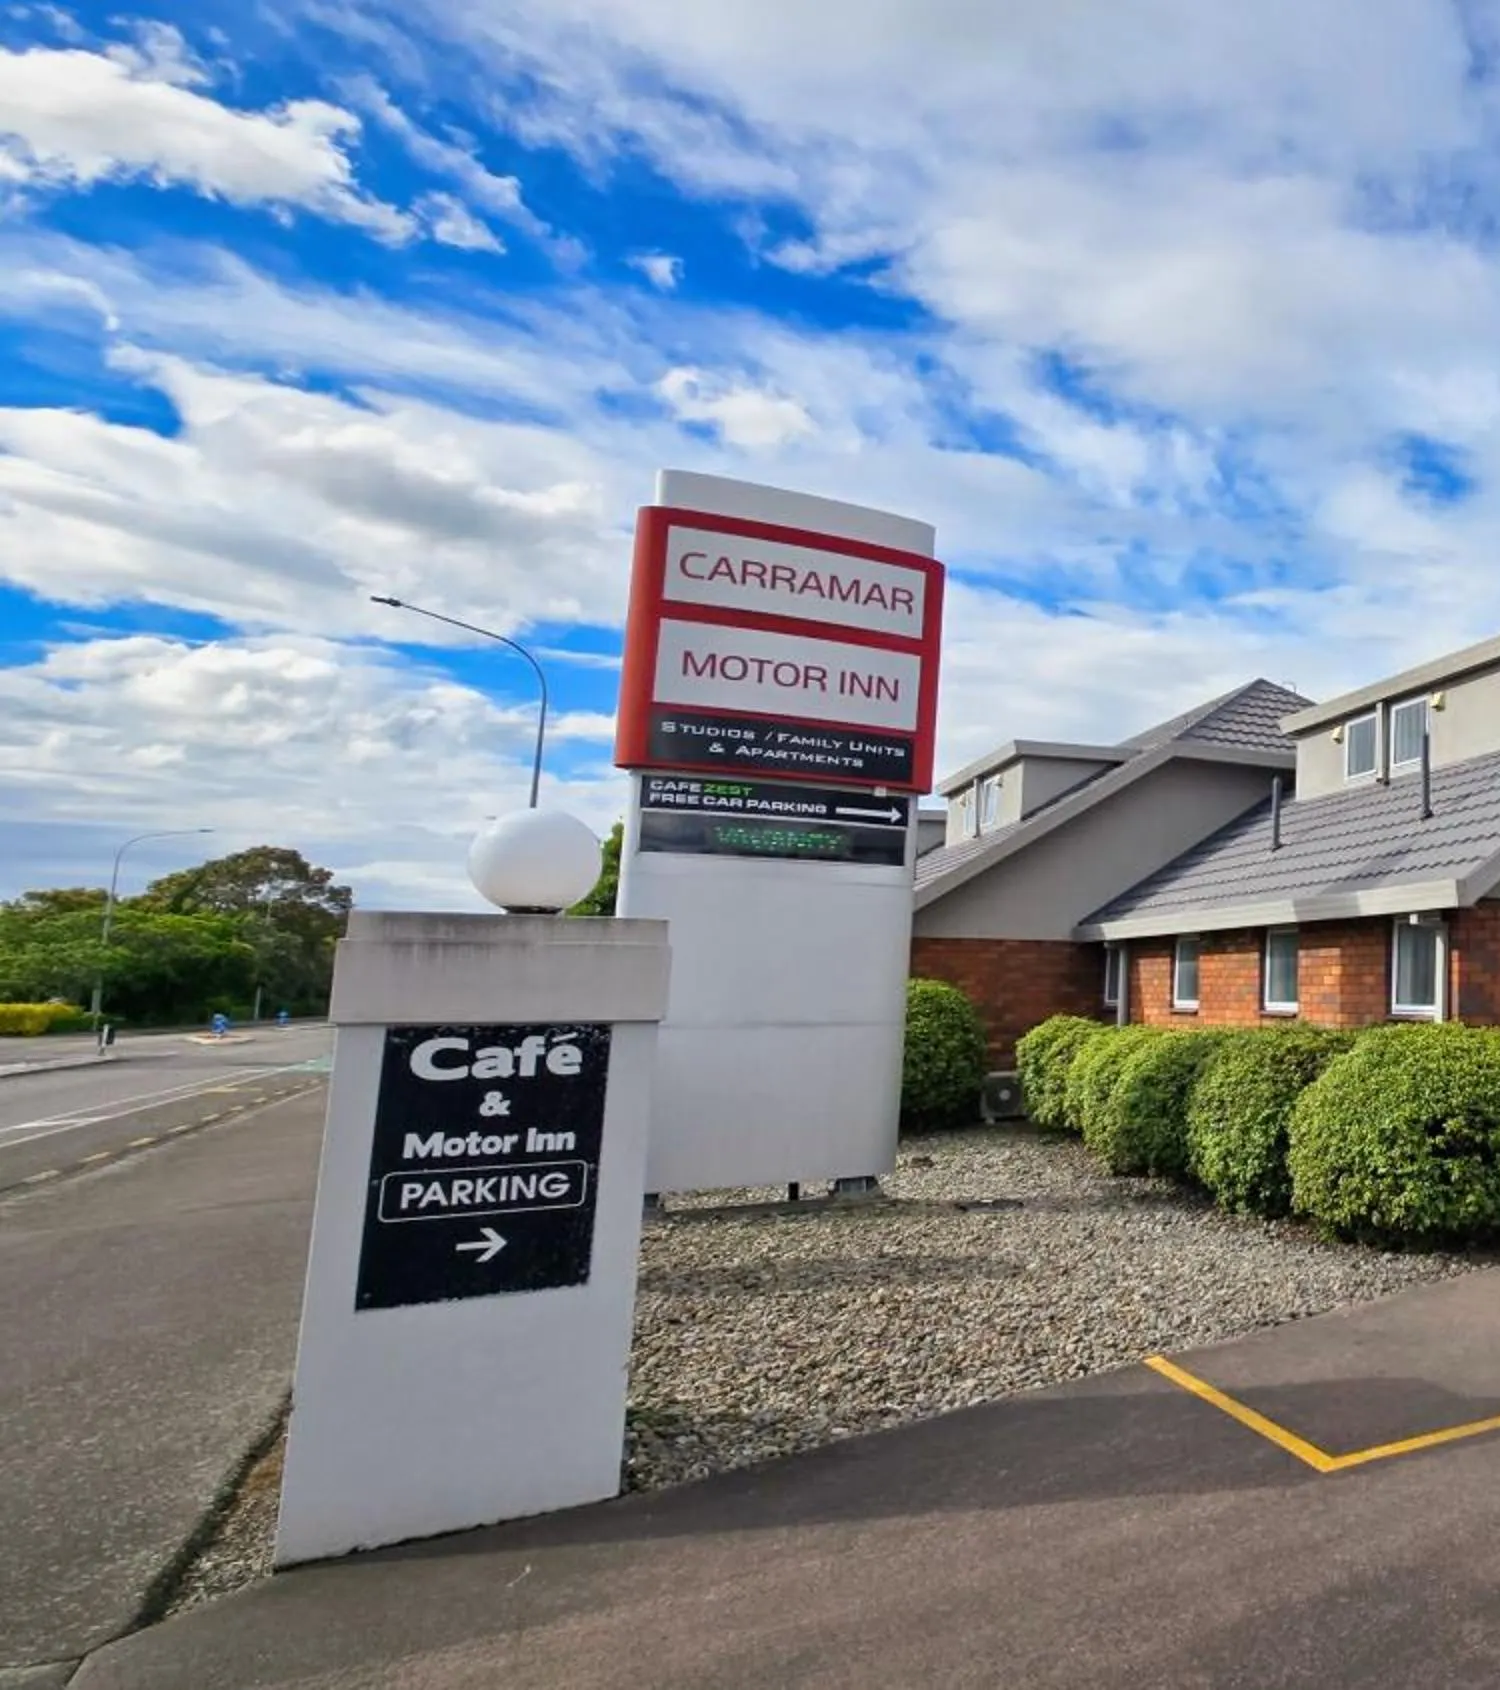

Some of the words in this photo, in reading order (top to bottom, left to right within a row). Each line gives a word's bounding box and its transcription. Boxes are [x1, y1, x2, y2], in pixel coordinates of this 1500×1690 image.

[679, 552, 914, 615] CARRAMAR
[682, 650, 827, 692] MOTOR
[839, 670, 900, 702] INN
[709, 742, 725, 753] &
[649, 792, 700, 805] FREE
[703, 795, 743, 807] CAR
[746, 799, 828, 814] PARKING
[650, 780, 701, 793] CAFE
[703, 783, 753, 796] ZEST
[409, 1031, 583, 1081] Café
[479, 1091, 511, 1117] &
[403, 1131, 519, 1159] Motor
[526, 1127, 576, 1153] Inn
[400, 1172, 571, 1210] PARKING
